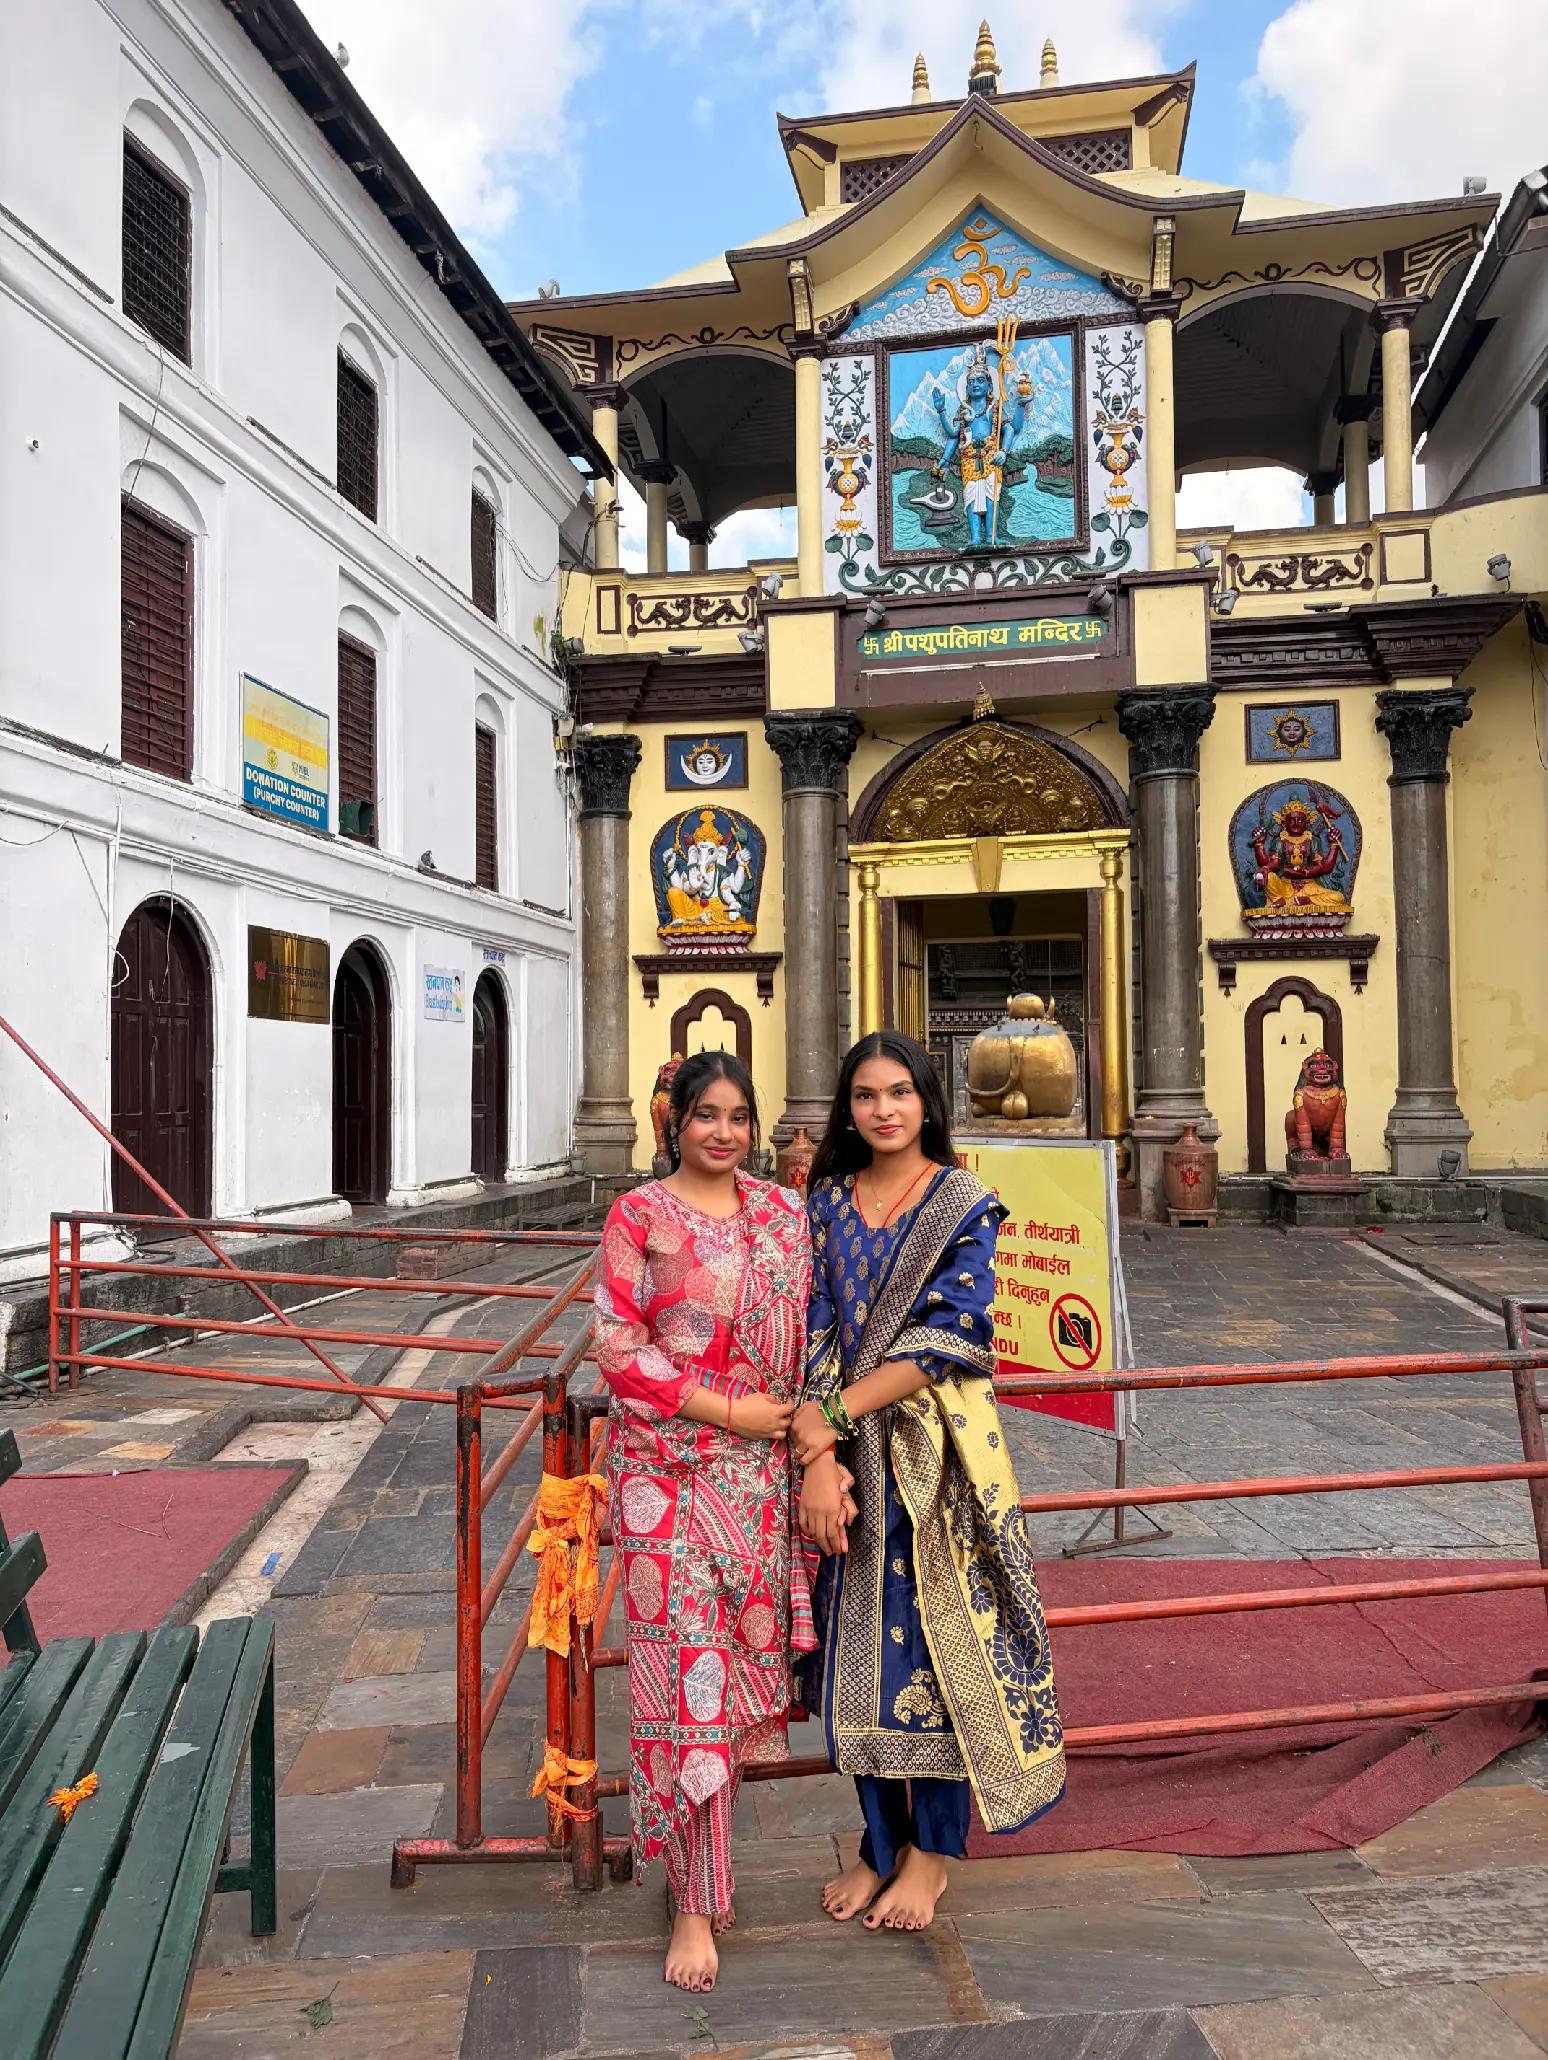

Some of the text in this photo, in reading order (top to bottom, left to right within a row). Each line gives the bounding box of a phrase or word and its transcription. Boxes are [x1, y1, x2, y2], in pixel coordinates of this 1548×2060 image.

[1018, 619, 1082, 642] मन्दिर
[246, 766, 326, 809] DONATION COUNTER
[285, 799, 320, 822] COUNTER)
[1024, 1219, 1080, 1245] तीर्थयात्री
[1021, 1250, 1070, 1276] मोबाईल
[1007, 1277, 1050, 1307] दिनुहुन
